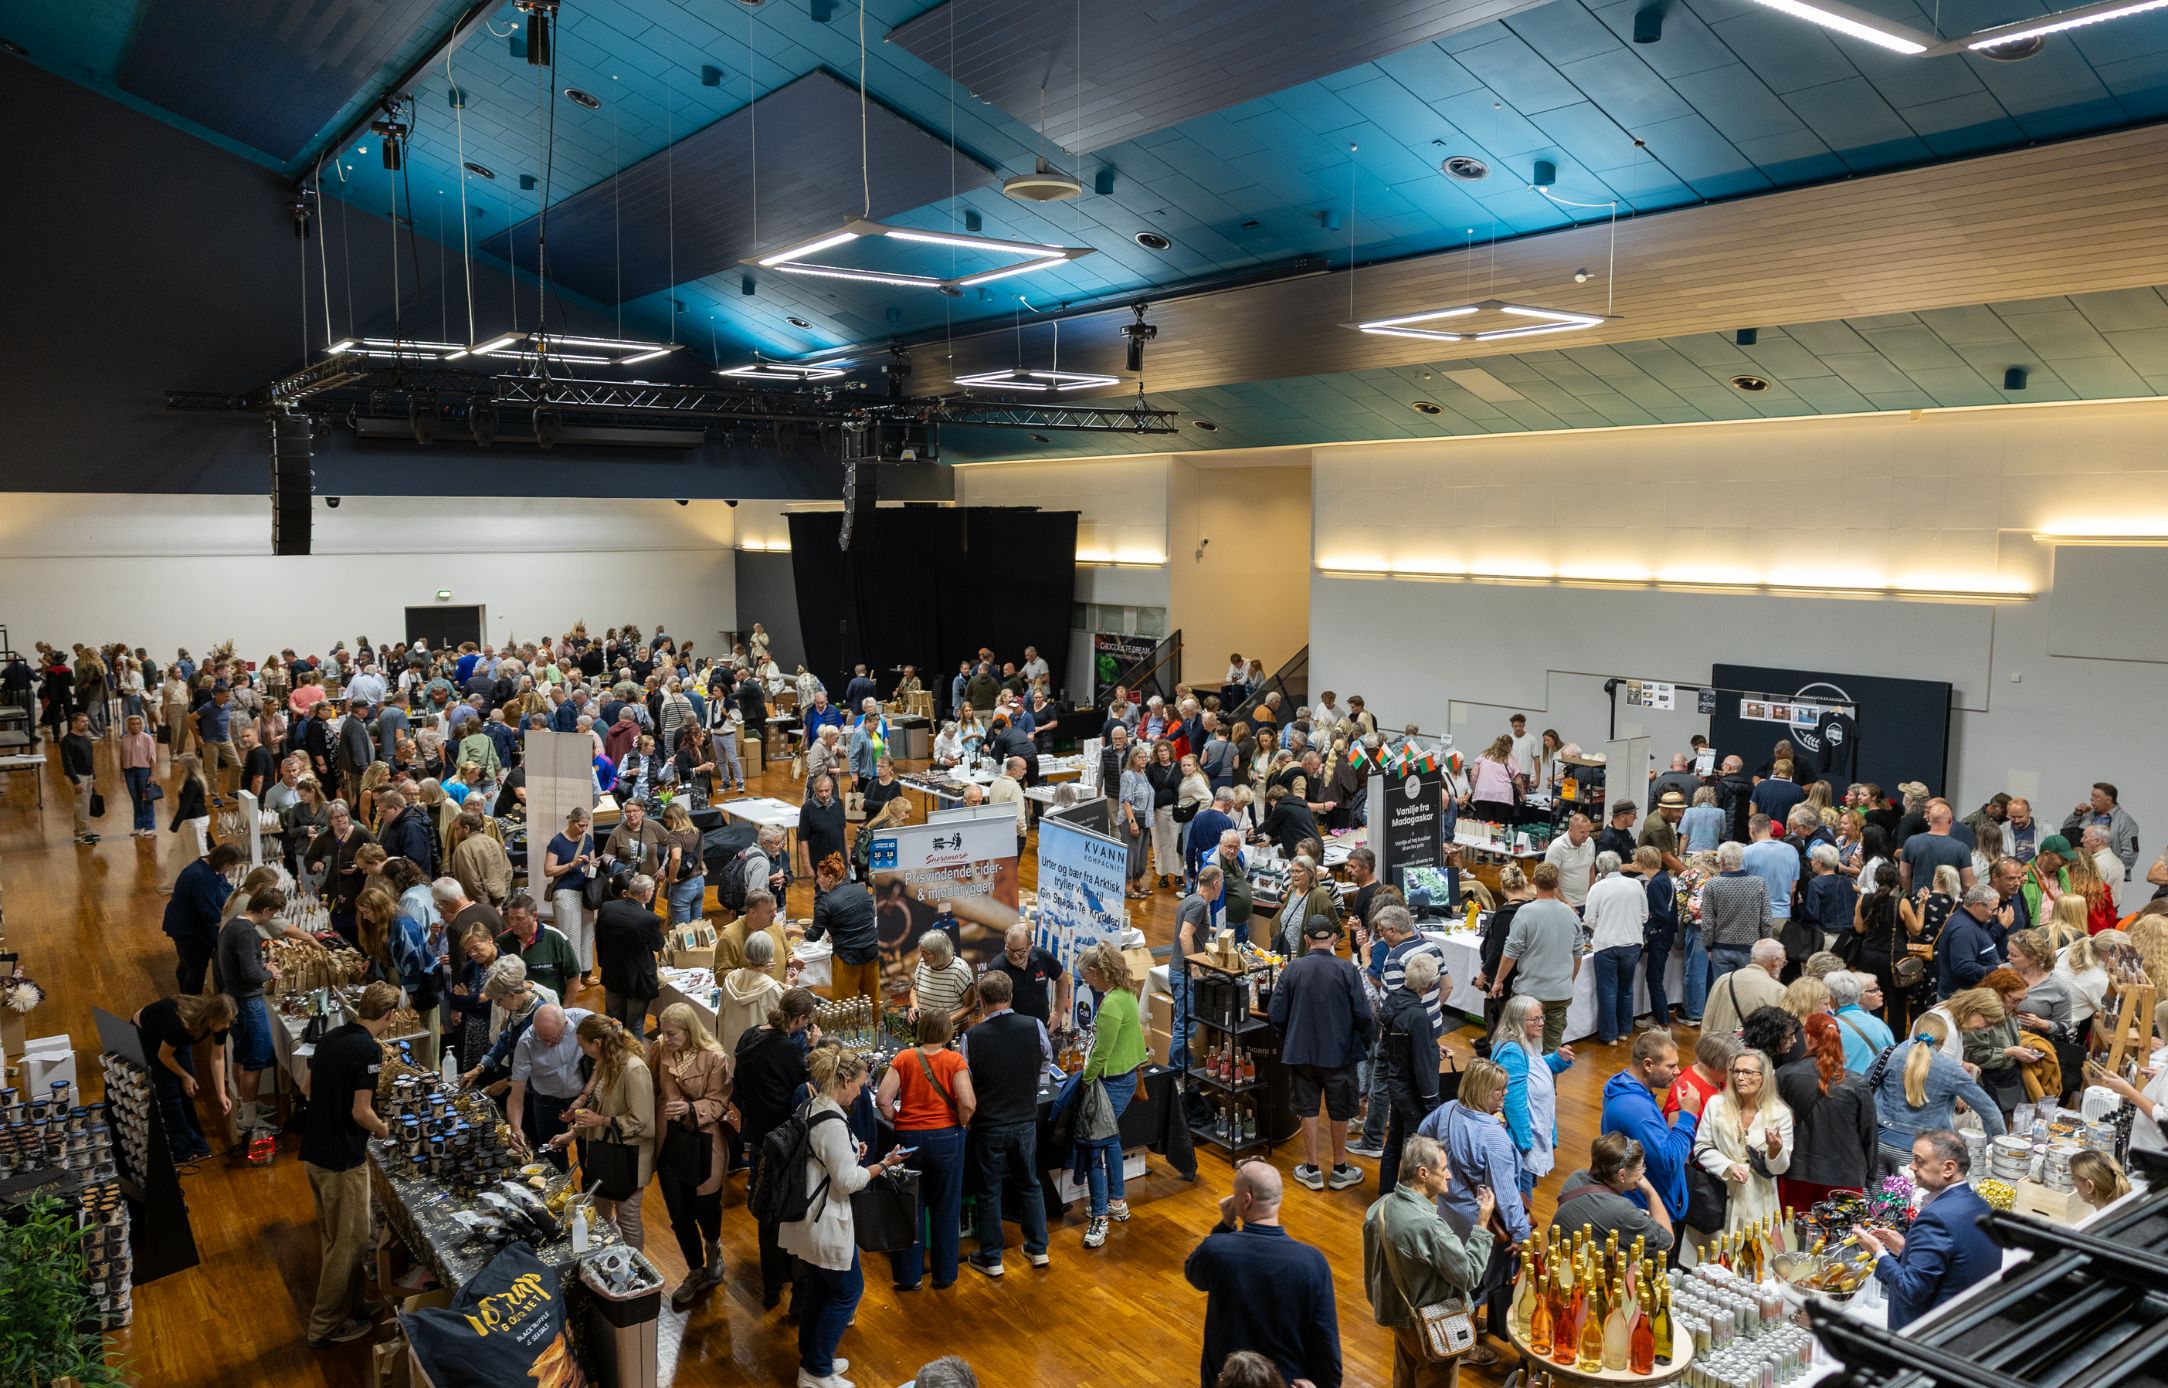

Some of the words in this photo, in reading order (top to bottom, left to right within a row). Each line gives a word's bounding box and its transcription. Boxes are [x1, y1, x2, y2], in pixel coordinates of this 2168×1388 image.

[1396, 804, 1419, 816] Vanilje
[1420, 803, 1429, 812] fra
[1392, 813, 1434, 827] Madagaskar
[1084, 840, 1125, 864] KVANN
[905, 866, 972, 885] Prisvindende
[974, 863, 1003, 878] cider-
[1042, 856, 1058, 871] Urter
[1058, 865, 1068, 877] og
[1069, 865, 1082, 879] bær
[1084, 870, 1092, 883] fra
[1084, 856, 1124, 874] KOMPAGNIET
[917, 888, 925, 901] &
[928, 880, 995, 901] mjødbryggeri
[1054, 876, 1075, 891] tryller
[976, 962, 987, 971] VM
[516, 1324, 533, 1342] BLACK
